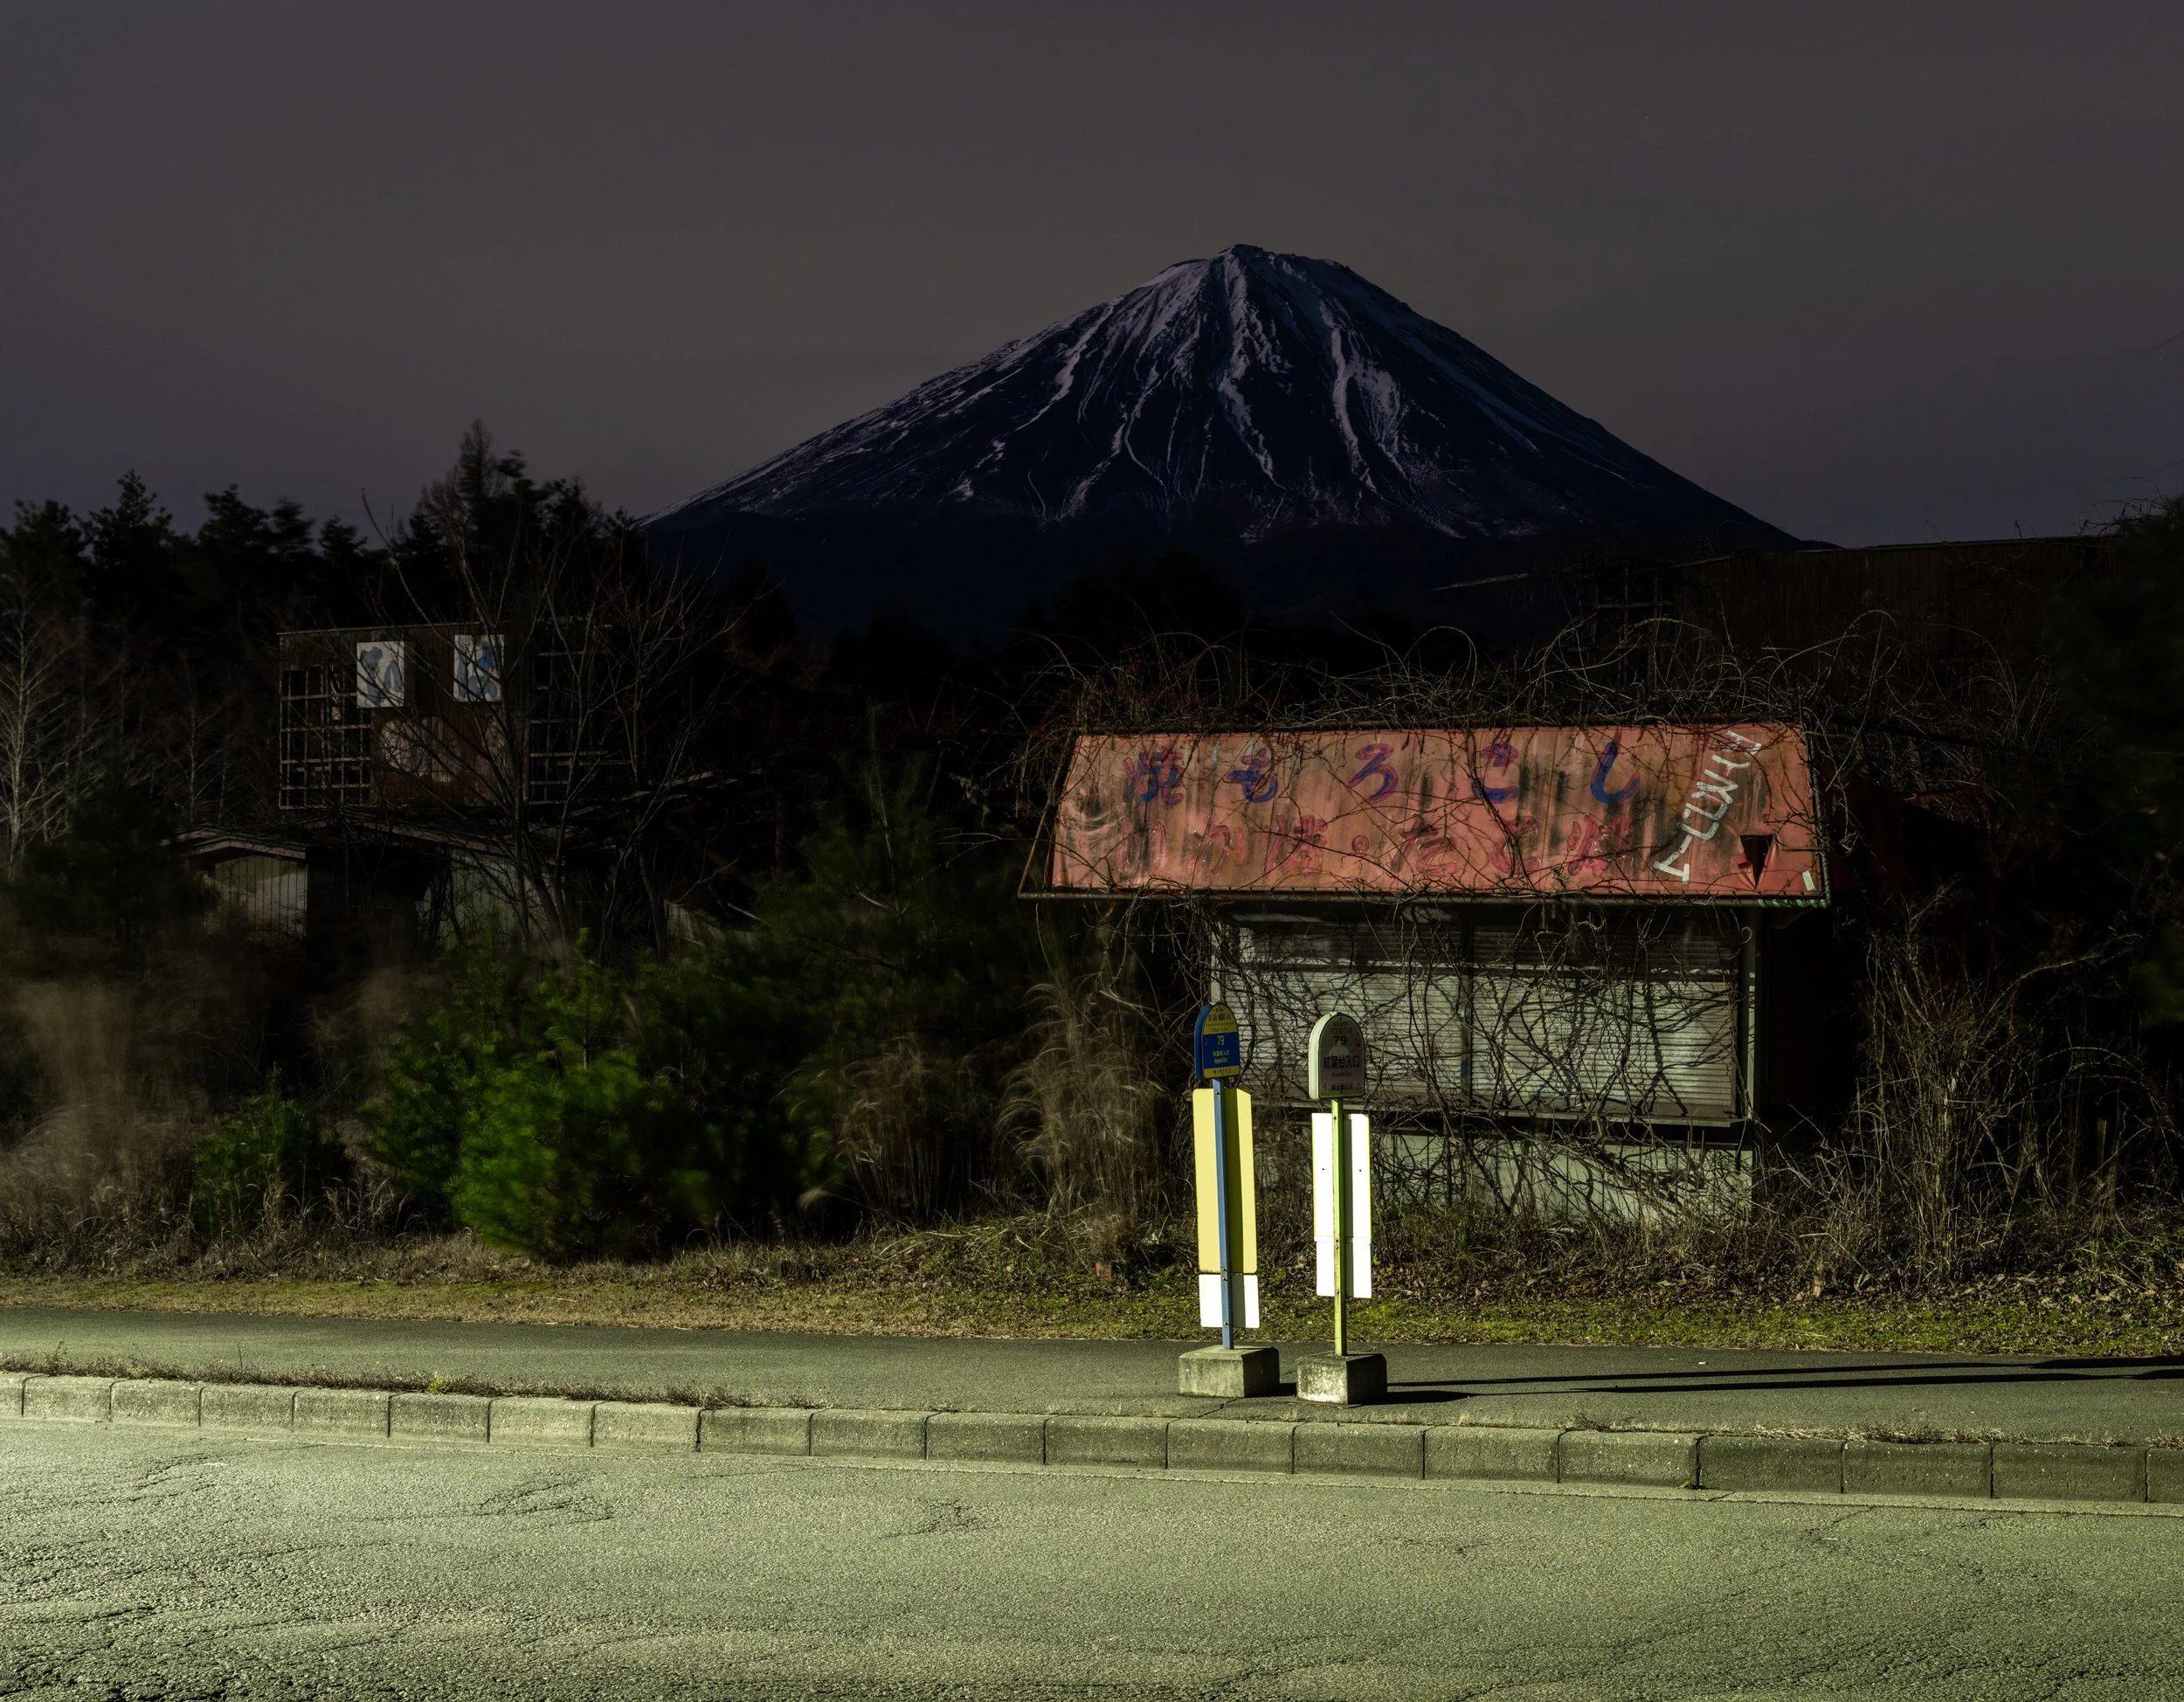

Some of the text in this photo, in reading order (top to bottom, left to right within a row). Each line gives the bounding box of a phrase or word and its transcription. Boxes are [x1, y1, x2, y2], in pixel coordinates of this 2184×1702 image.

[1123, 741, 1640, 806] 焼もろこし
[1217, 1035, 1225, 1046] 79
[1333, 1035, 1347, 1046] 79
[1324, 1055, 1359, 1069] 紅葉台入口
